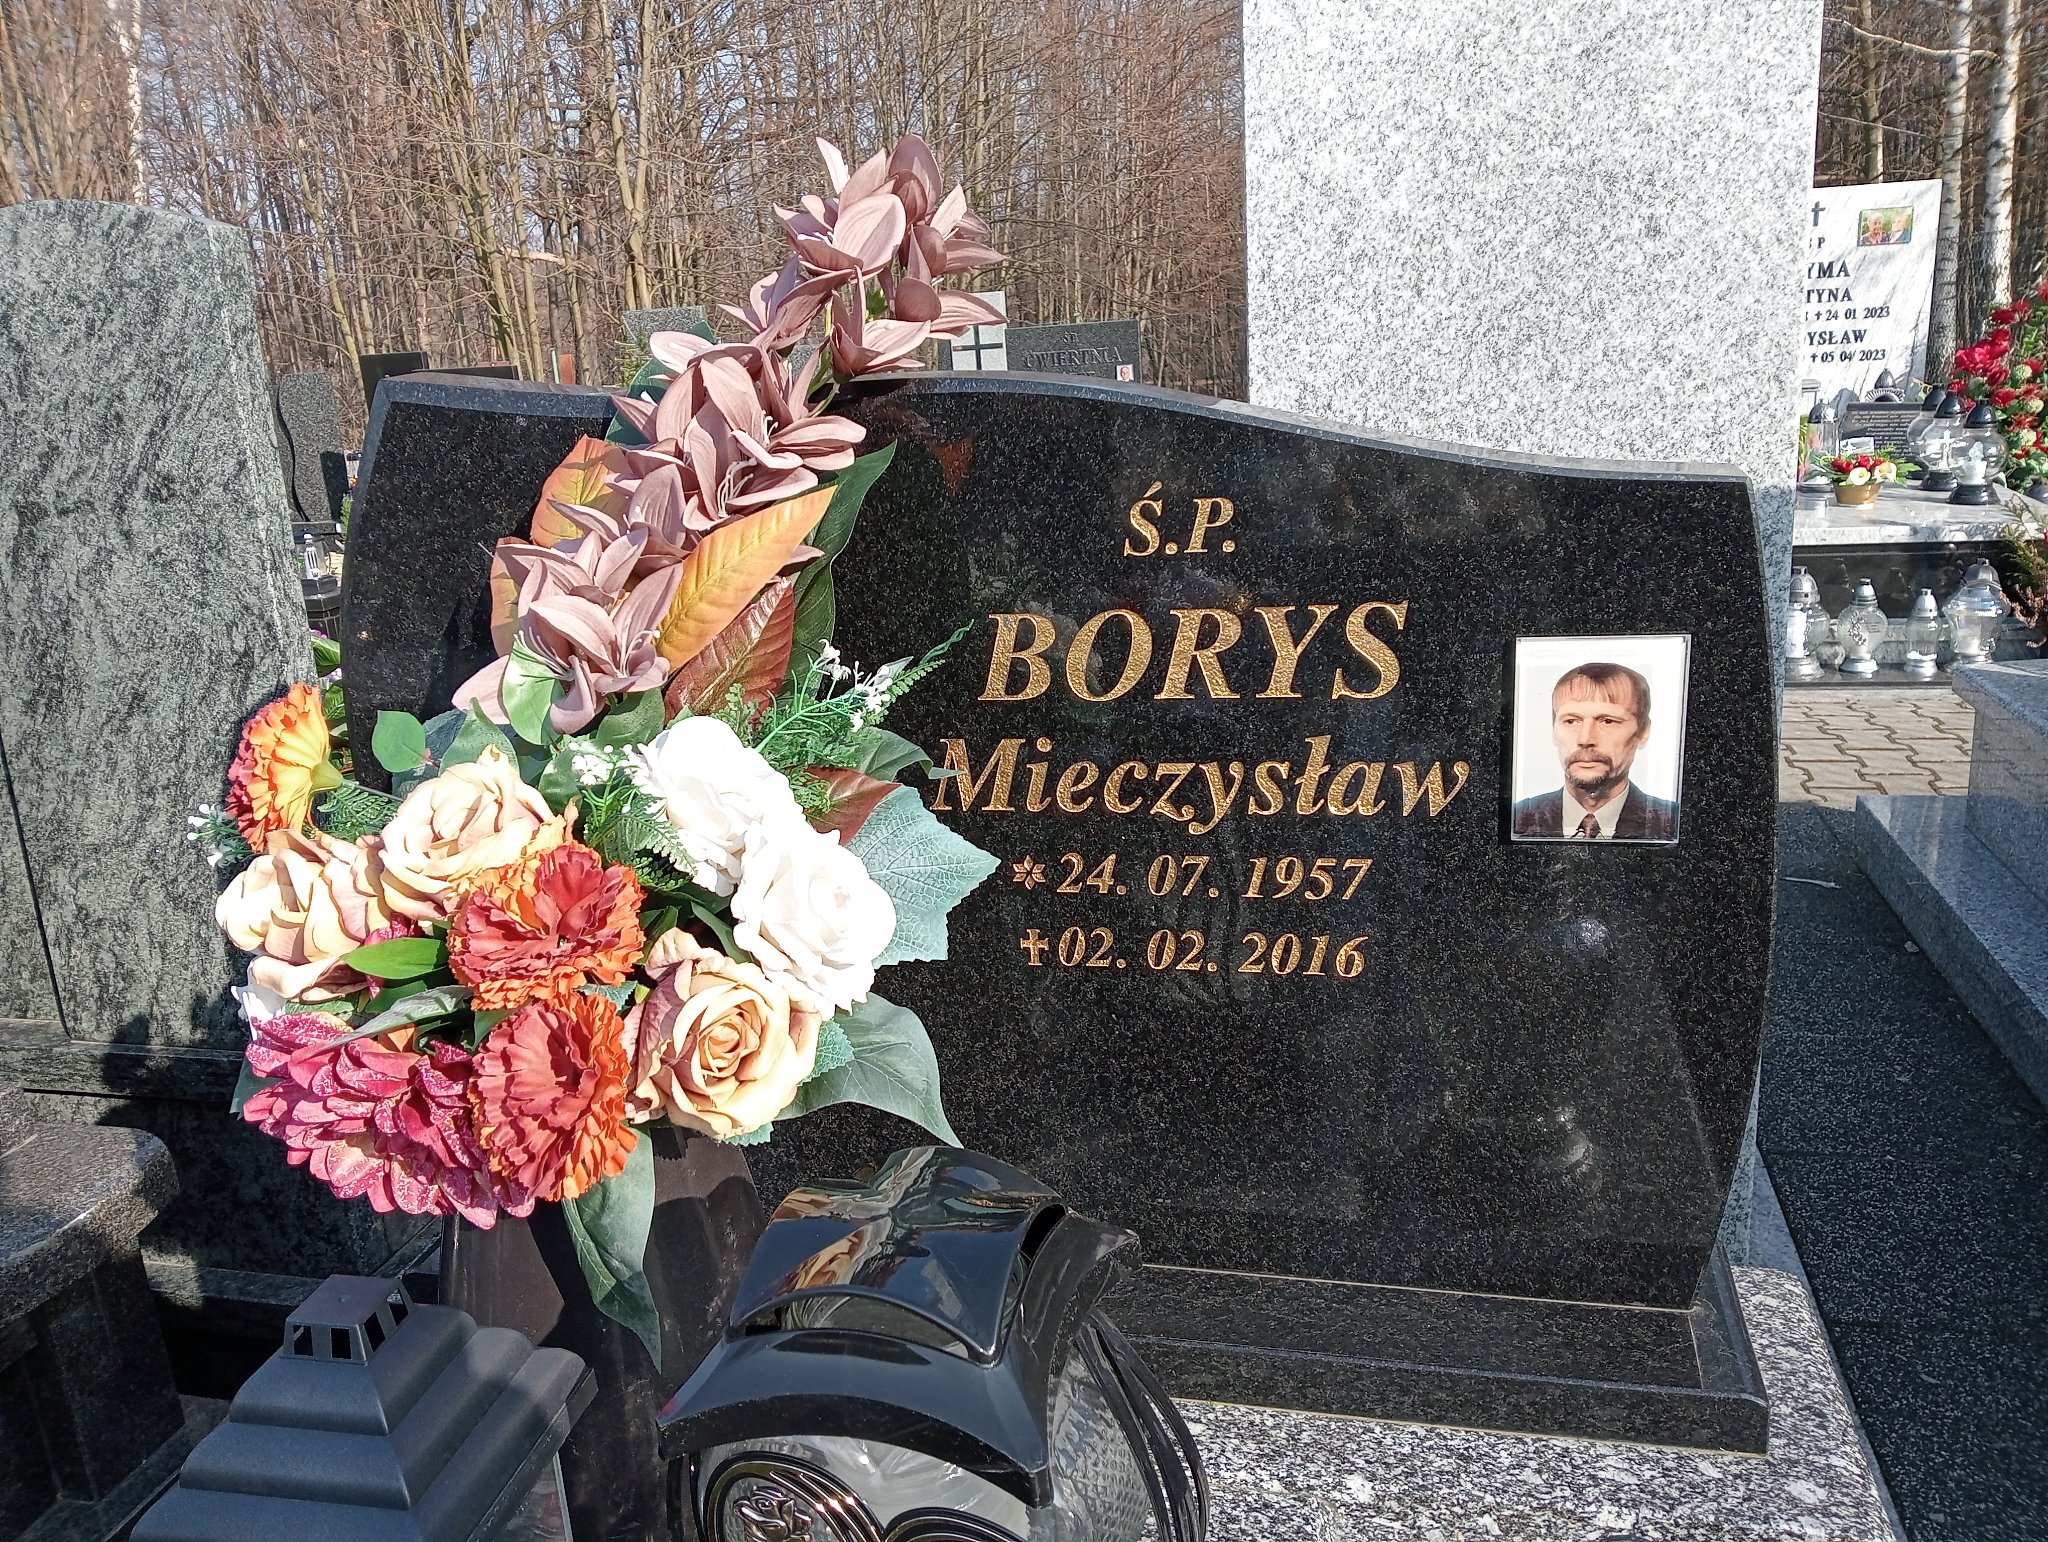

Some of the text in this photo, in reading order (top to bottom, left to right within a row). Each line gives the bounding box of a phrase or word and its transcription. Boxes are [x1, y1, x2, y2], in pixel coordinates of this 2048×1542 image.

[1804, 328, 1868, 346] YSŁAW
[1825, 305, 1890, 321] 24 01 2023
[1821, 351, 1835, 363] 05
[1859, 348, 1887, 362] 2023
[1123, 480, 1238, 558] Ś.P.
[977, 599, 1410, 702] BORYS
[929, 734, 1471, 836] Mieczysław
[1056, 852, 1374, 901] 24. 07. 1957
[1058, 926, 1370, 979] 02. 02. 2016
